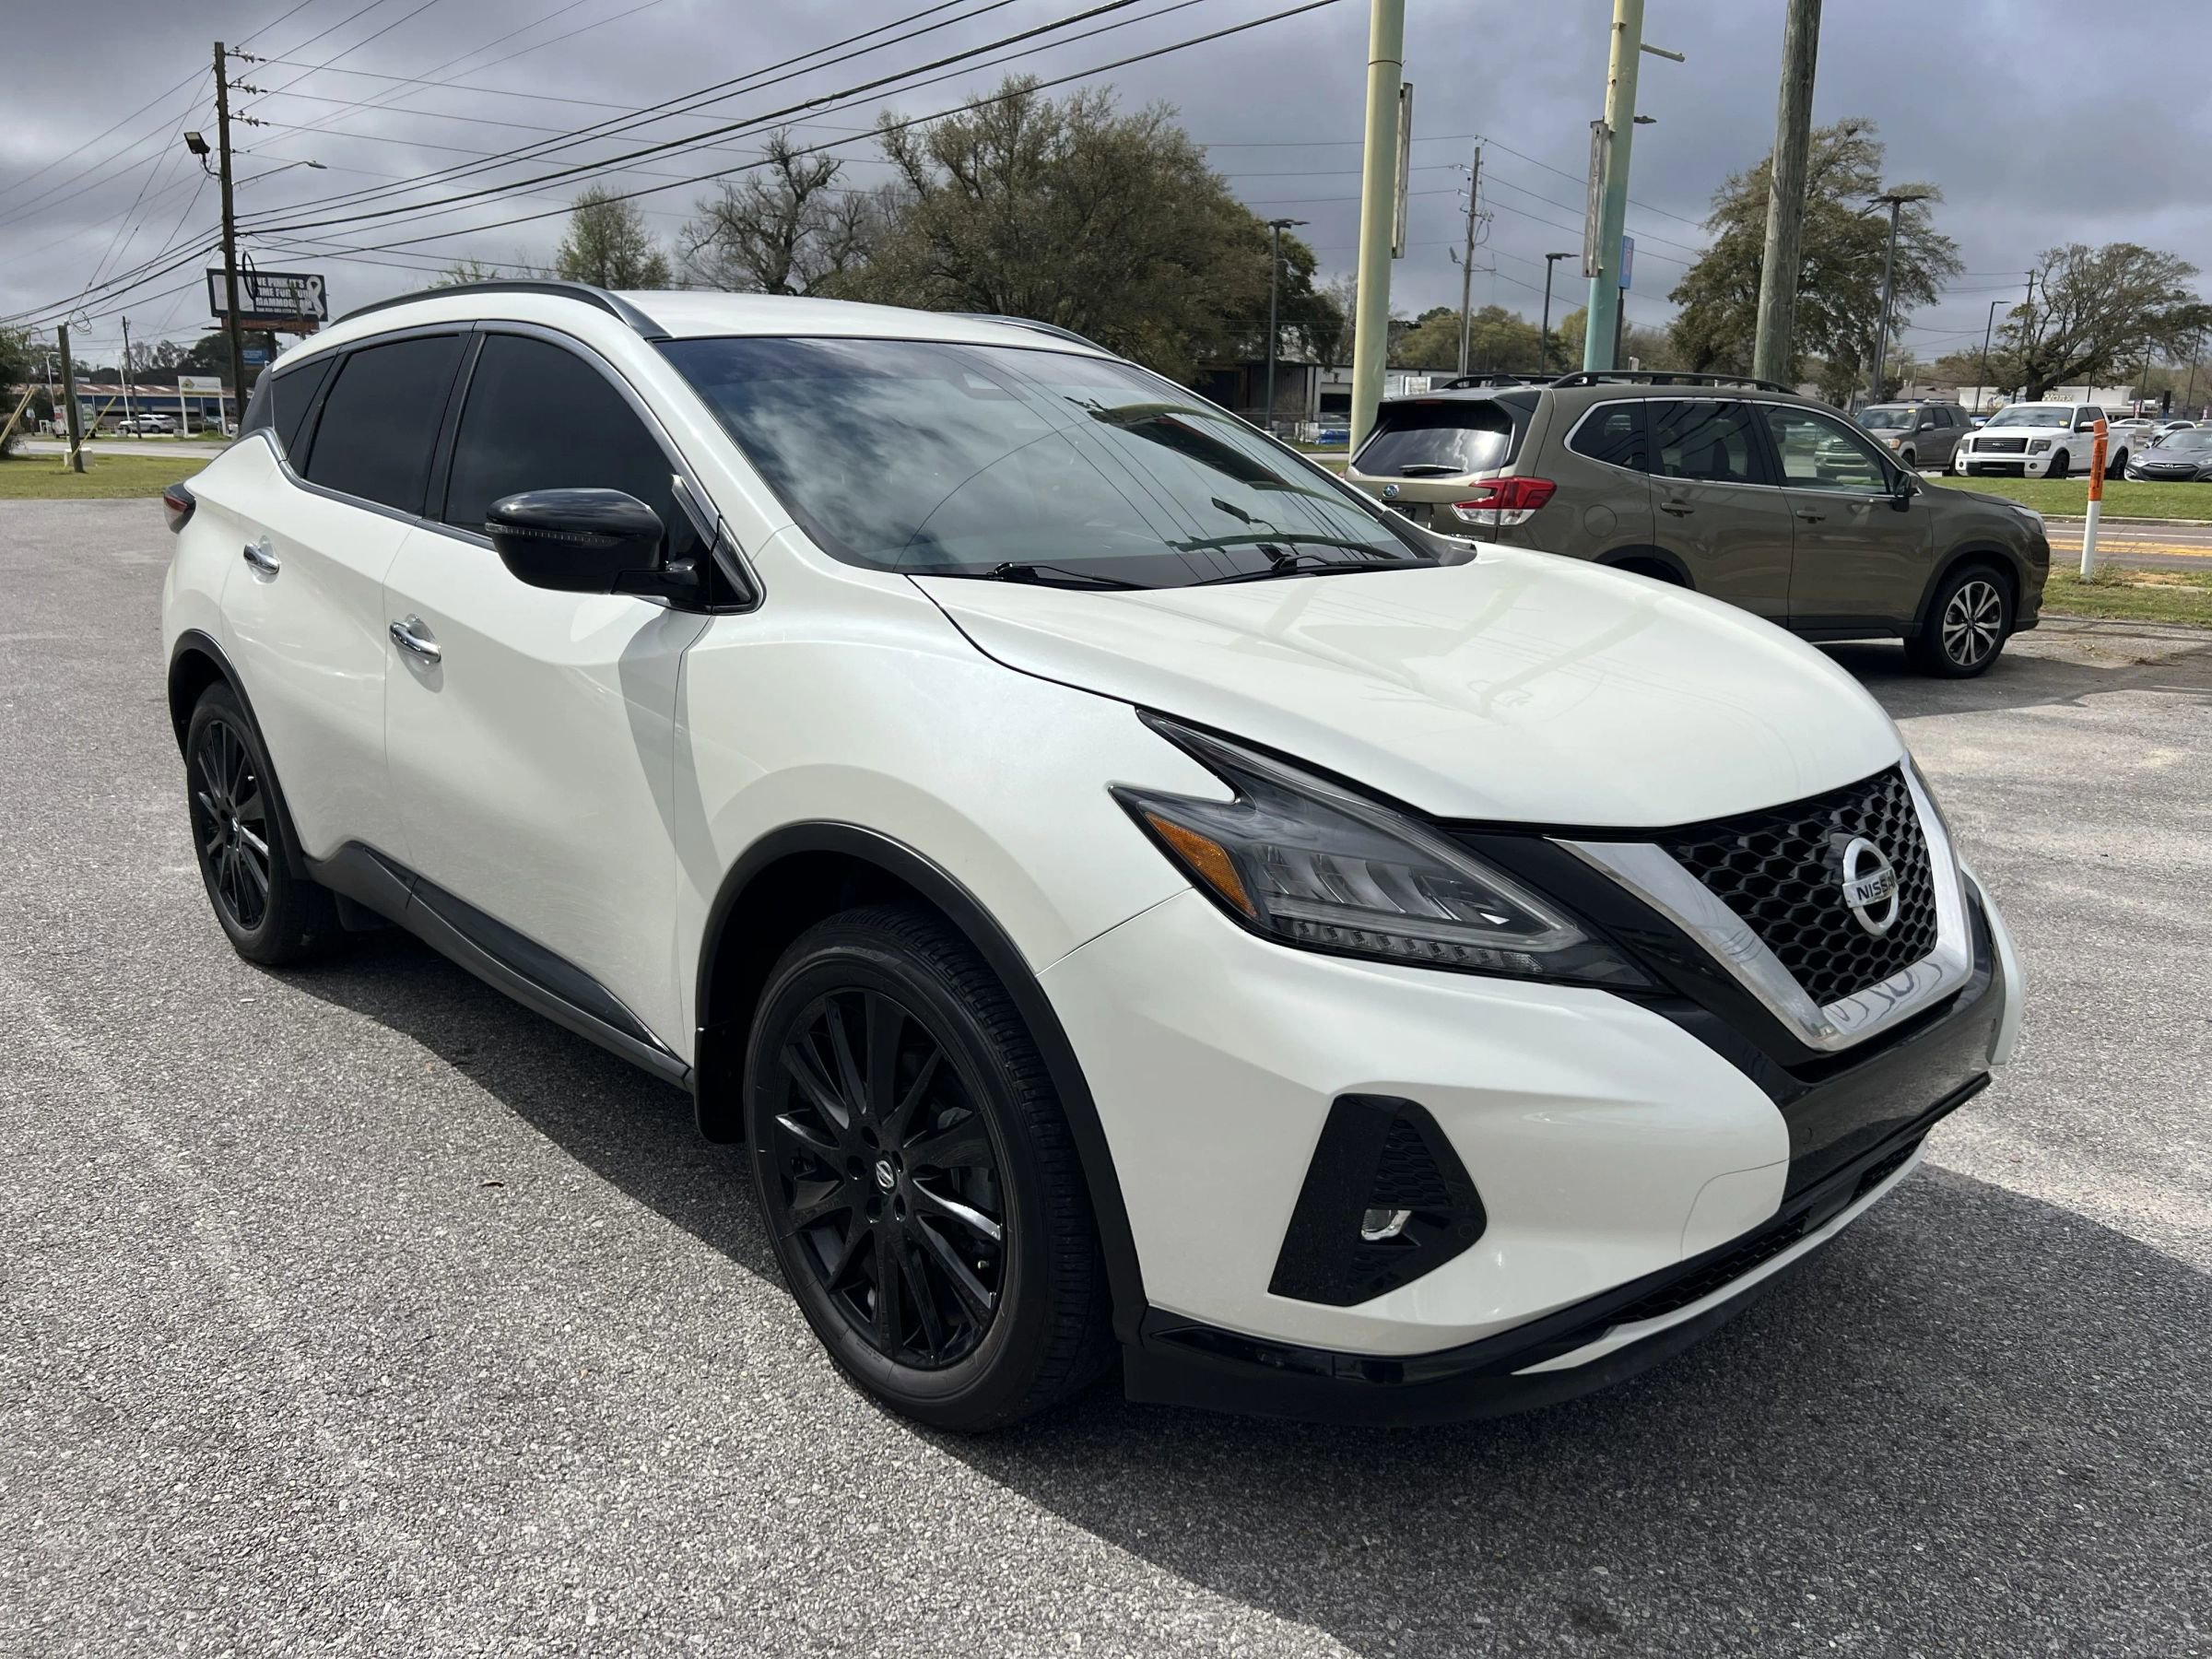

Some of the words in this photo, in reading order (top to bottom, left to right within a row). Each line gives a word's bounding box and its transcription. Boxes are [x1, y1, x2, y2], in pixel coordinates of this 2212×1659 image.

[267, 277, 288, 288] PINK
[276, 288, 291, 298] FOR
[1856, 876, 1896, 900] NISSA
